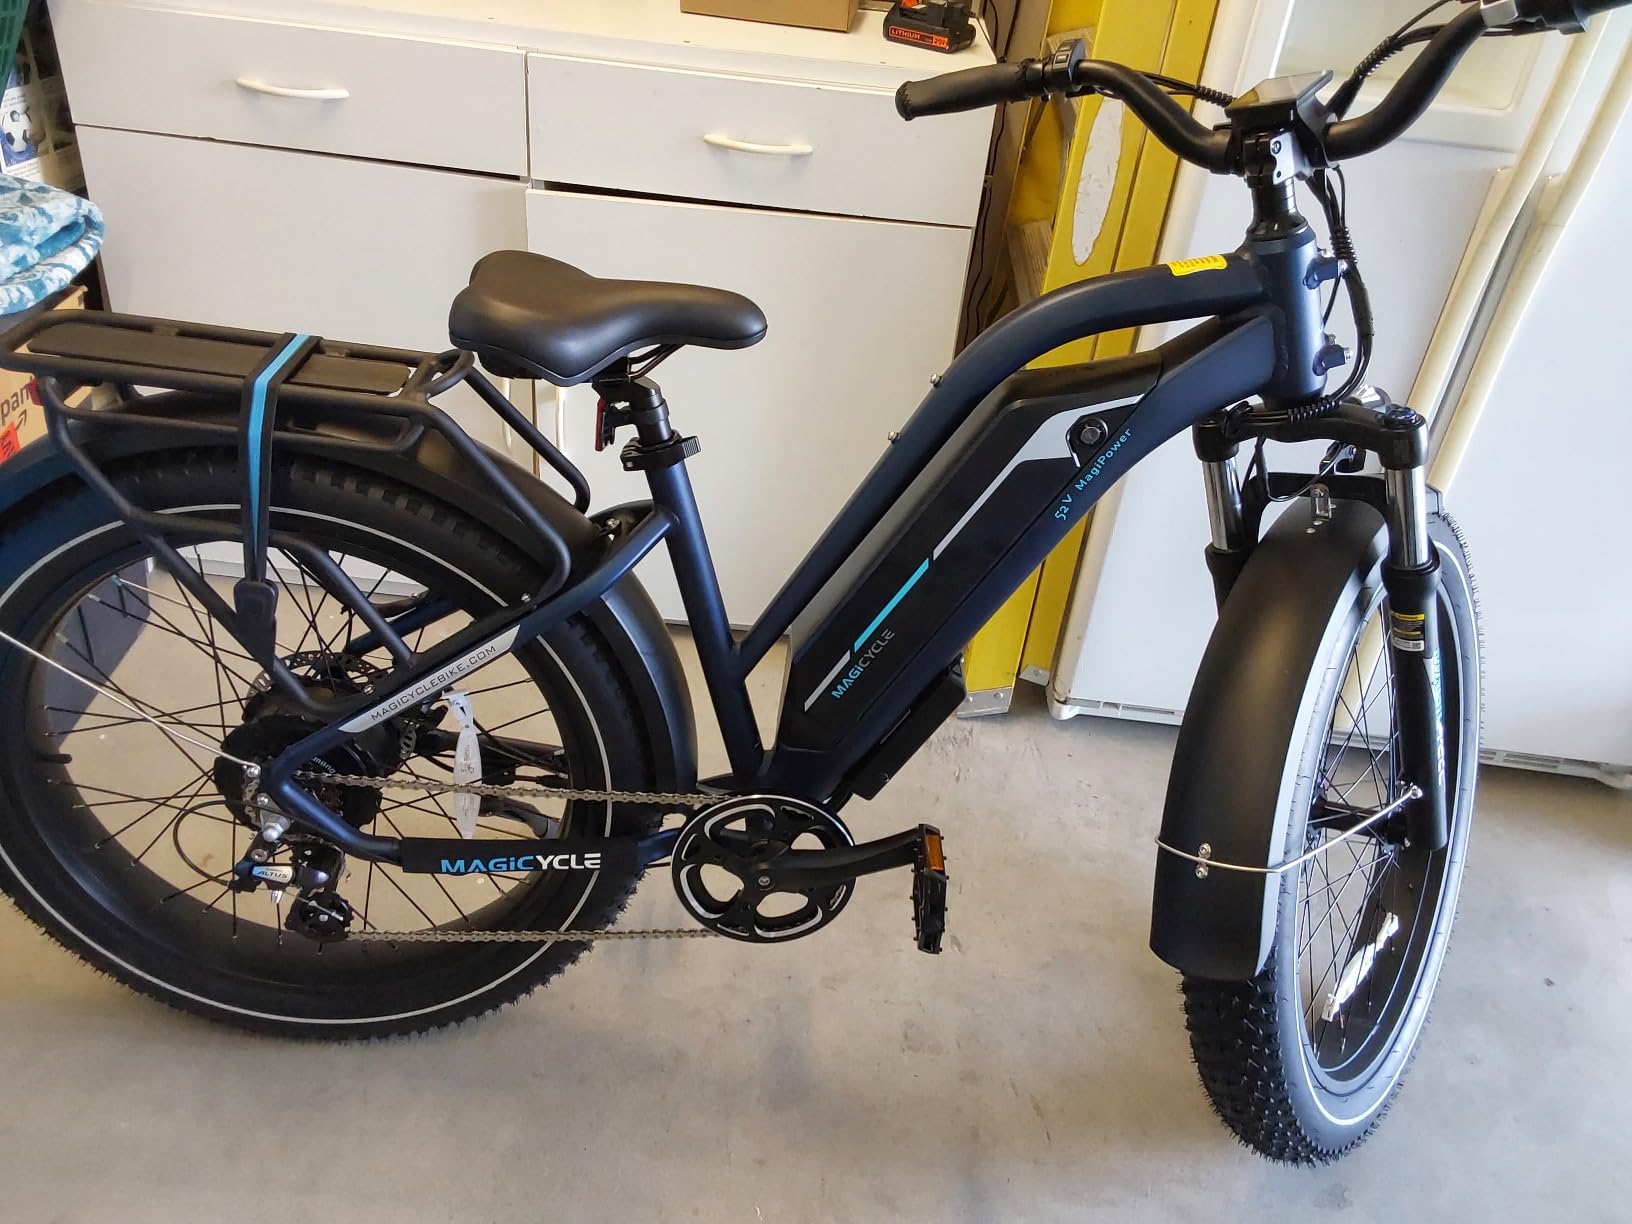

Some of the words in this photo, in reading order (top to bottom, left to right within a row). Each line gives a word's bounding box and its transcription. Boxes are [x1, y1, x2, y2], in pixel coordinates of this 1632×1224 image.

[891, 29, 921, 40] LITHIUM
[1075, 427, 1133, 491] MagiPower
[371, 645, 497, 721] MAGICYCLEBIKE.COM
[257, 870, 289, 879] ALTUS
